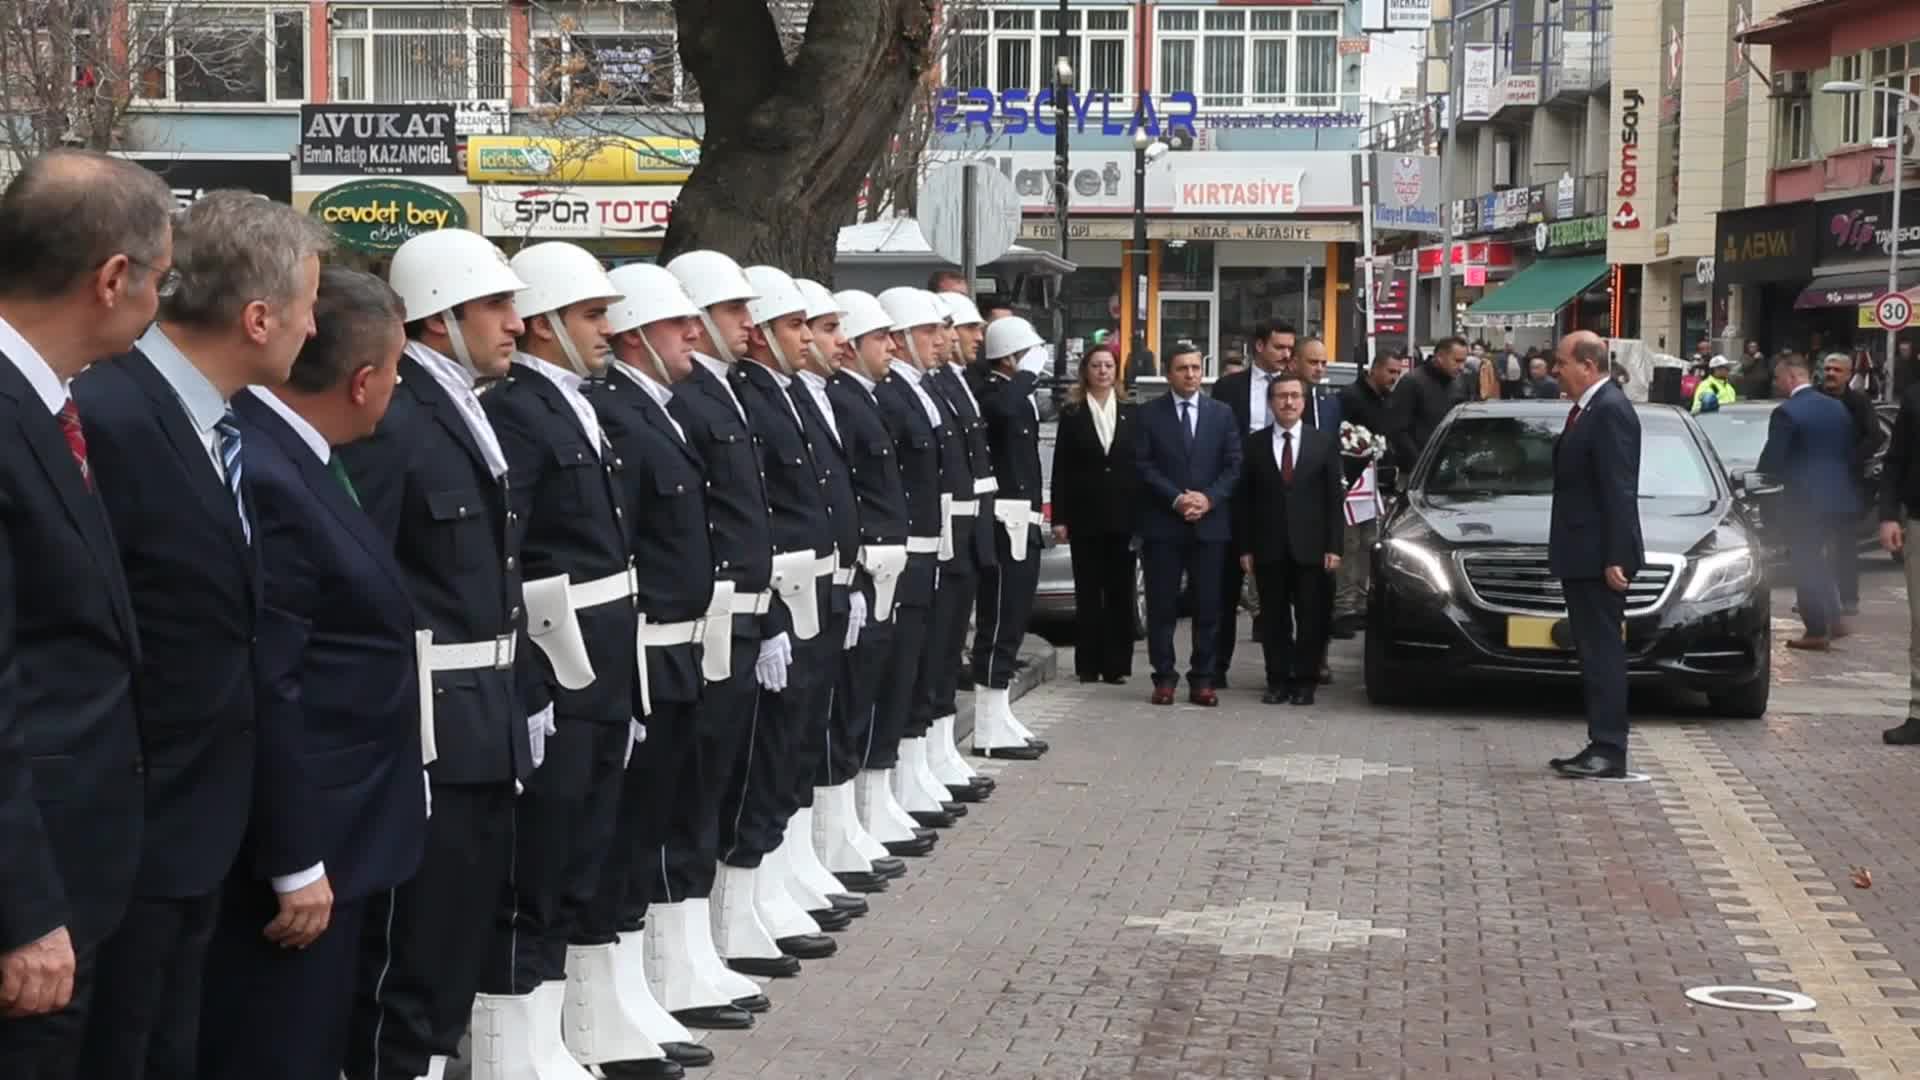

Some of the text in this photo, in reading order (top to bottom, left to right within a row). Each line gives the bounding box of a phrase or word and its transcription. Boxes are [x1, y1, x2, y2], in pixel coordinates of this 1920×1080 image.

[305, 113, 450, 138] AVUKAT
[303, 144, 332, 163] Emin
[1617, 89, 1645, 198] tamsay
[1183, 178, 1294, 205] KIRTASİYE
[323, 200, 449, 230] cevdet bey
[515, 200, 590, 223] SPOR
[1883, 303, 1906, 321] 30
